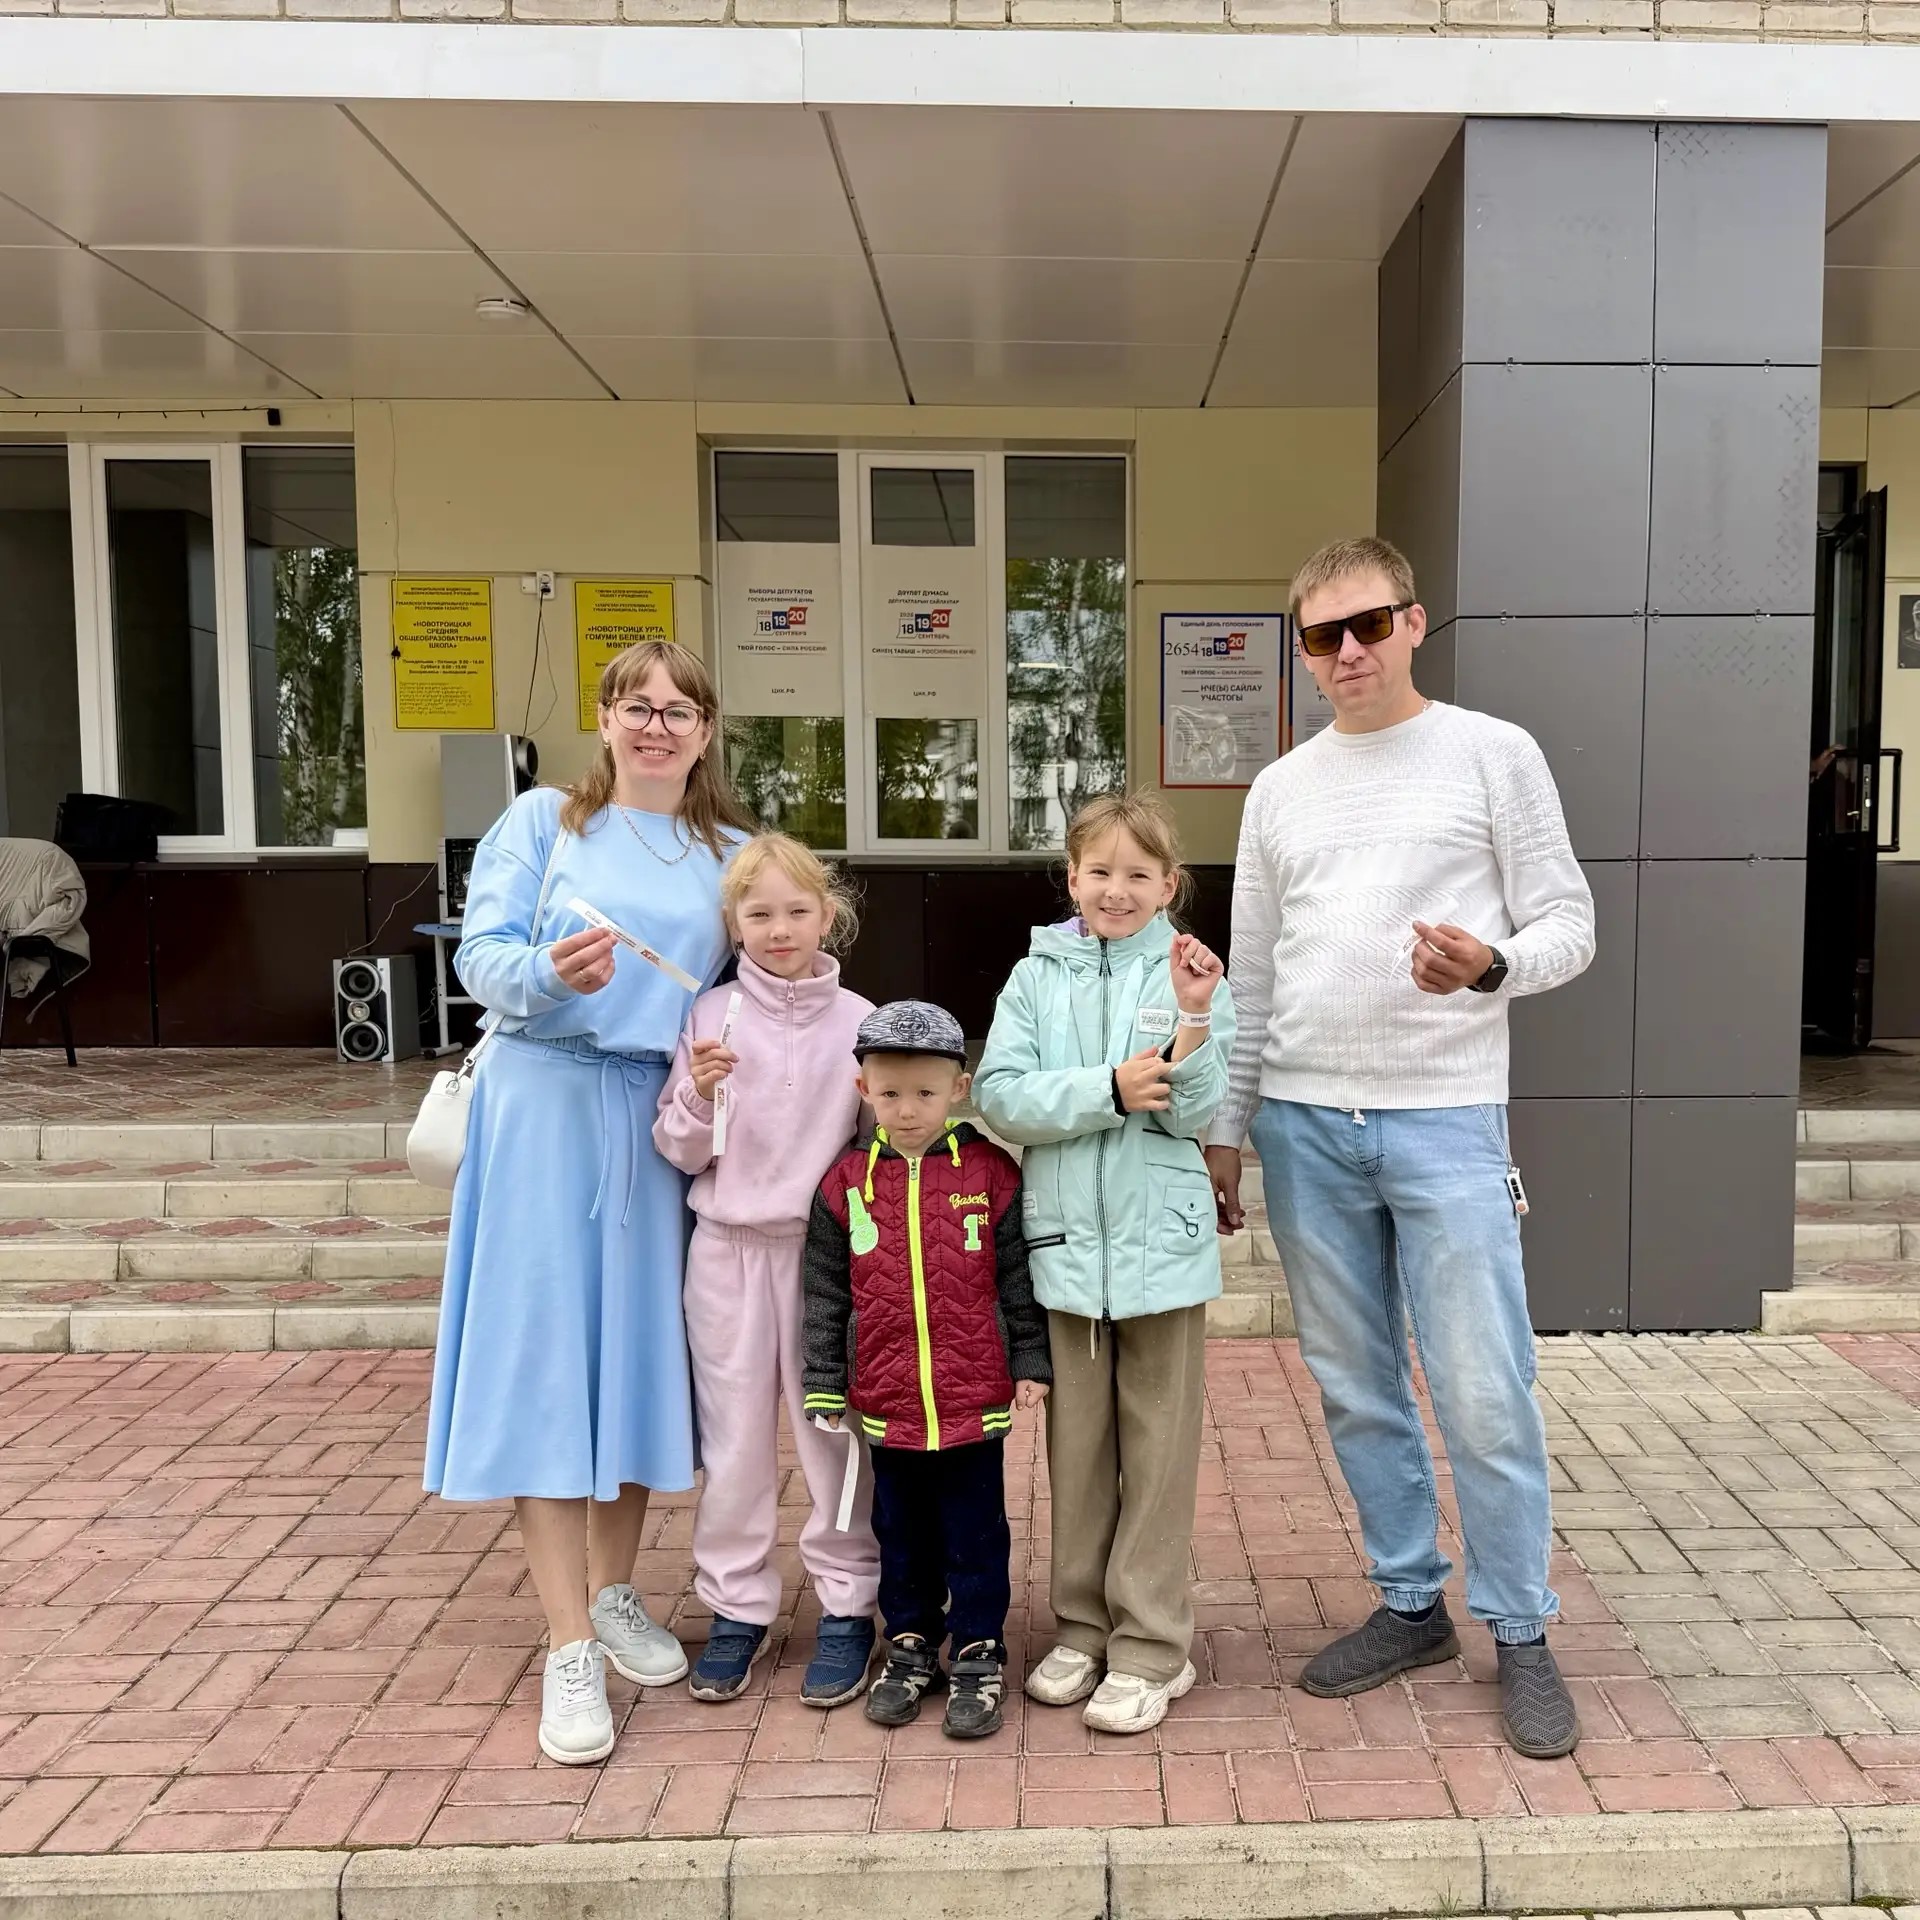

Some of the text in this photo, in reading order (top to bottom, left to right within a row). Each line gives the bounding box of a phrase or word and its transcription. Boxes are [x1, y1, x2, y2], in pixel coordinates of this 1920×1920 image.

[759, 610, 805, 632] 18 19 20
[901, 613, 948, 635] 18 19 20
[1165, 642, 1199, 656] 2654
[1201, 636, 1244, 657] 18 19 20
[1230, 683, 1263, 692] САЙЛАУ
[1200, 694, 1243, 702] УЧАСТОГЫ
